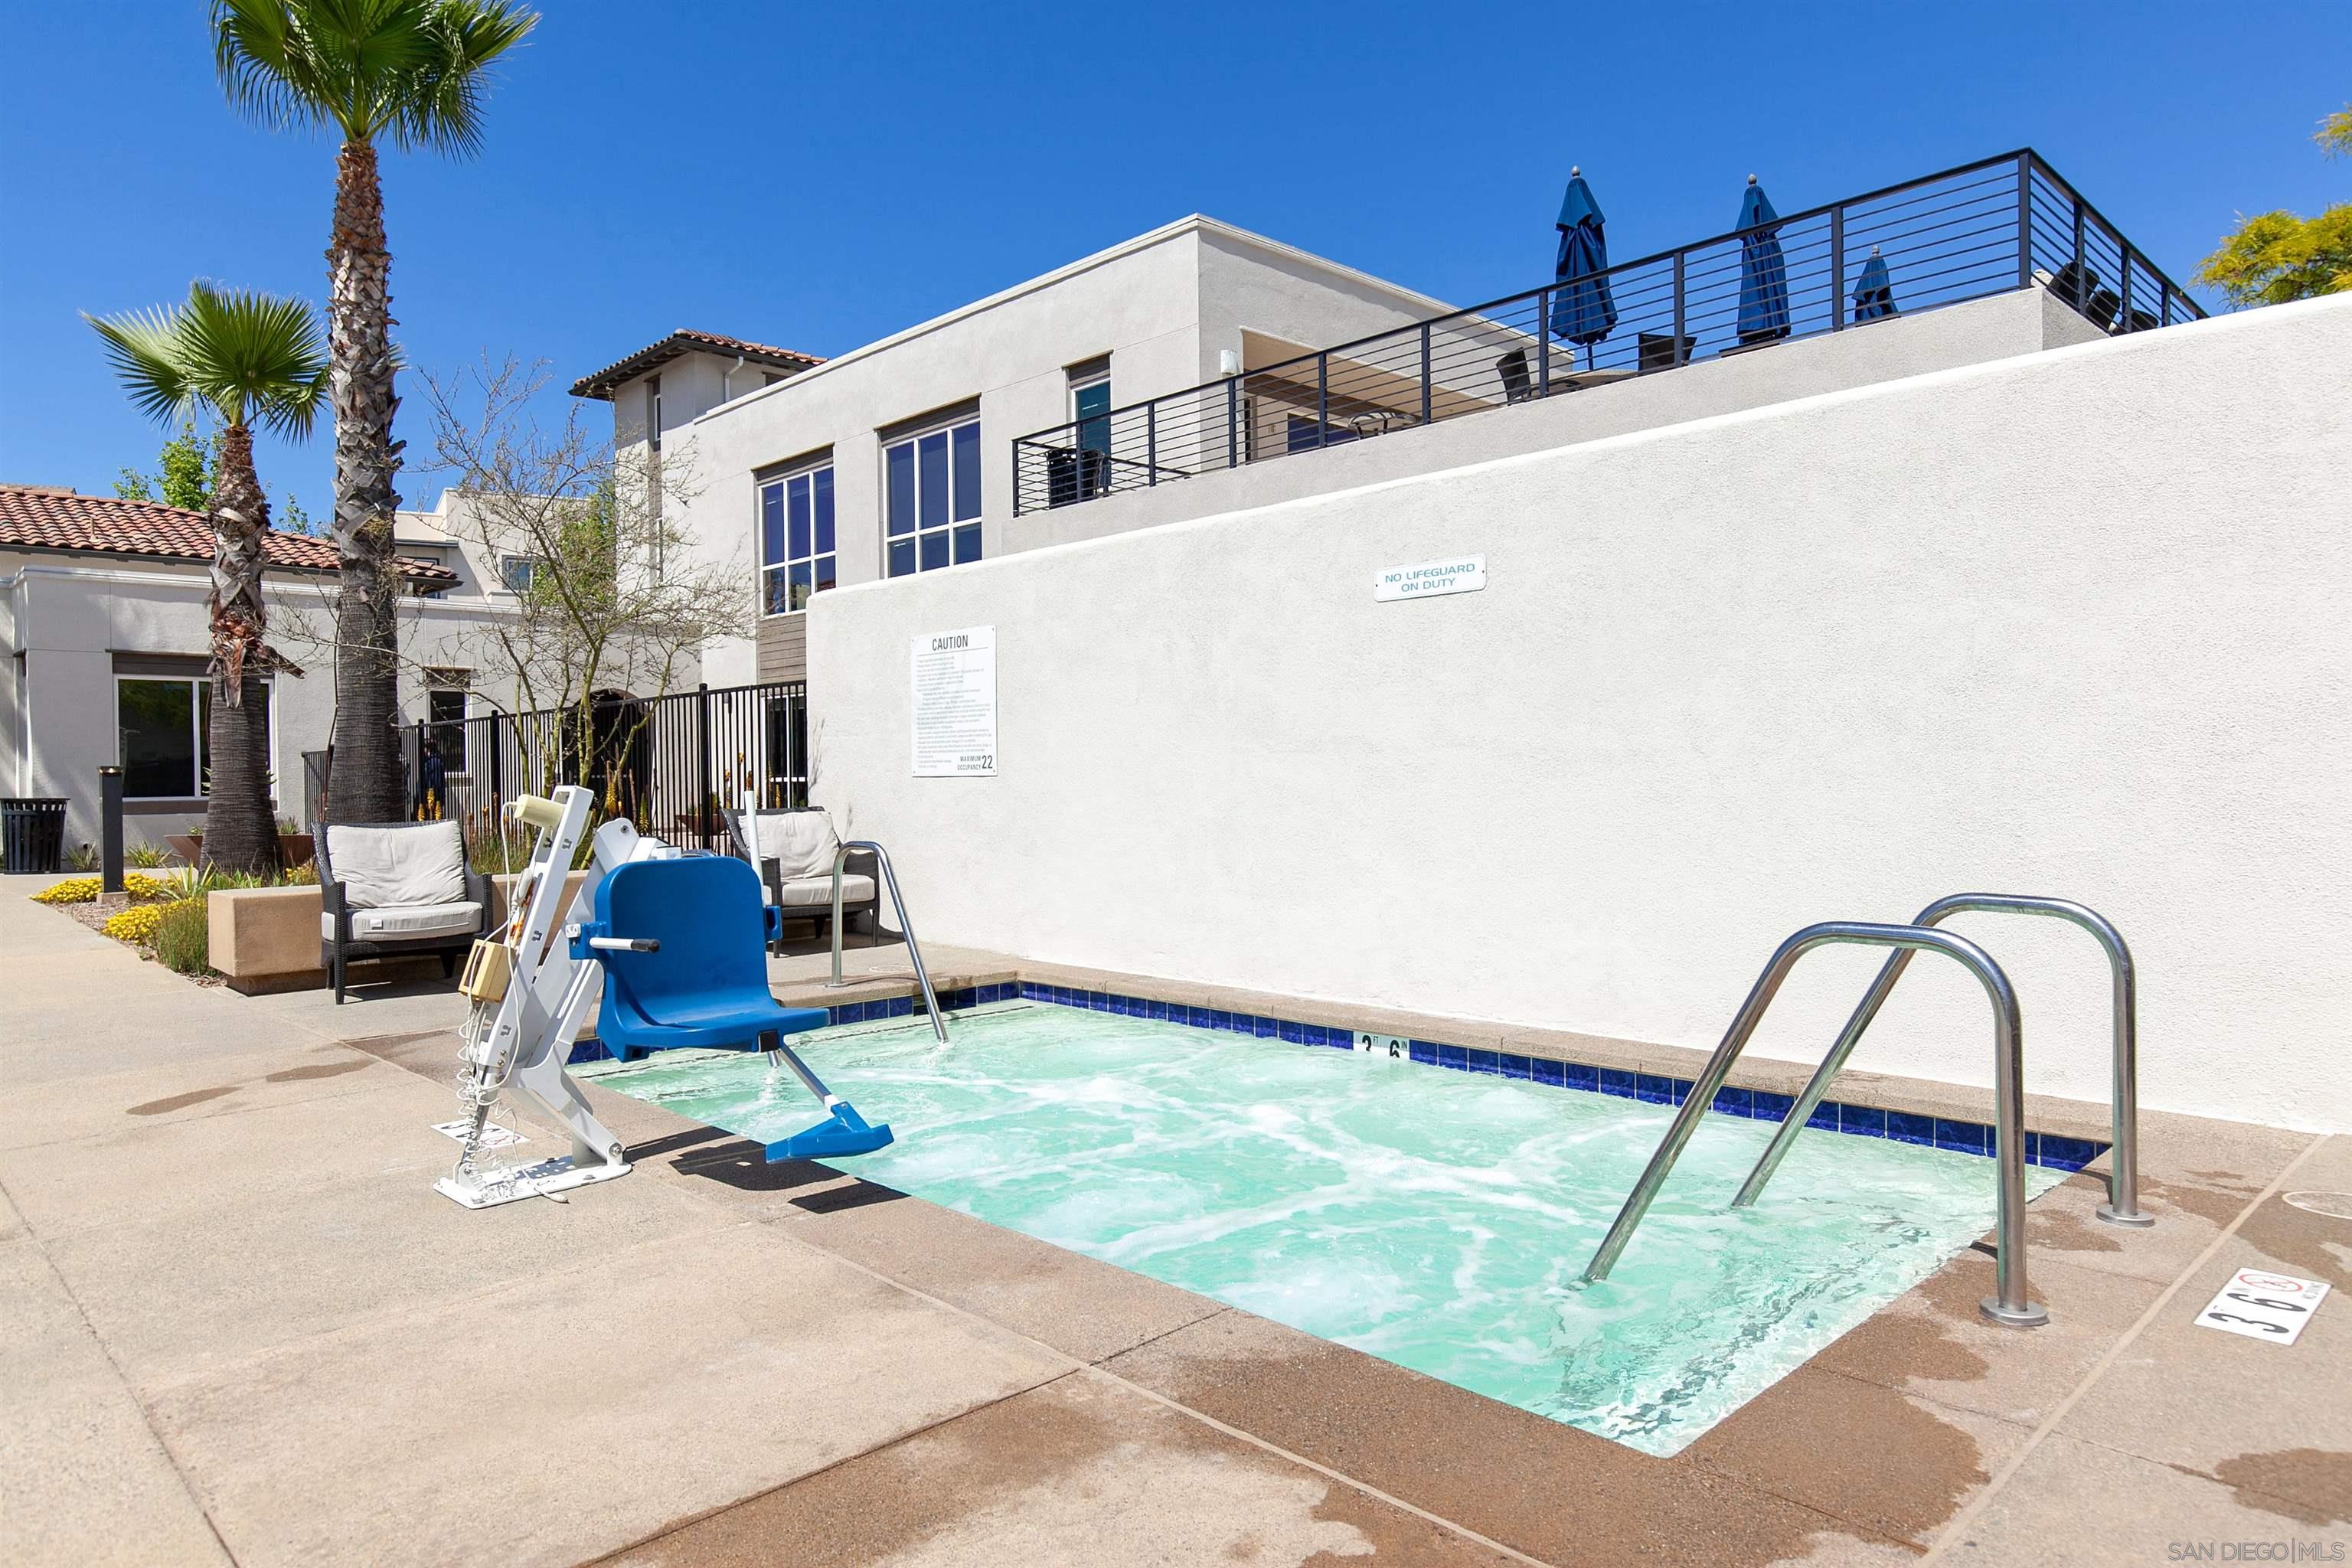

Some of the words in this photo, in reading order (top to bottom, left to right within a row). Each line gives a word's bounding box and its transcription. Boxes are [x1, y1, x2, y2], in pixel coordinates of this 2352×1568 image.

[1385, 573, 1402, 583] NO
[1406, 564, 1475, 580] LIFEGUARD
[1401, 583, 1419, 593] ON
[1423, 577, 1455, 590] DUTY
[932, 634, 969, 651] CAUTION
[982, 754, 993, 769] 22
[1373, 1035, 1379, 1044] FT
[1401, 1040, 1407, 1050] IN
[2226, 1292, 2308, 1312] 6
[2207, 1312, 2290, 1334] 3
